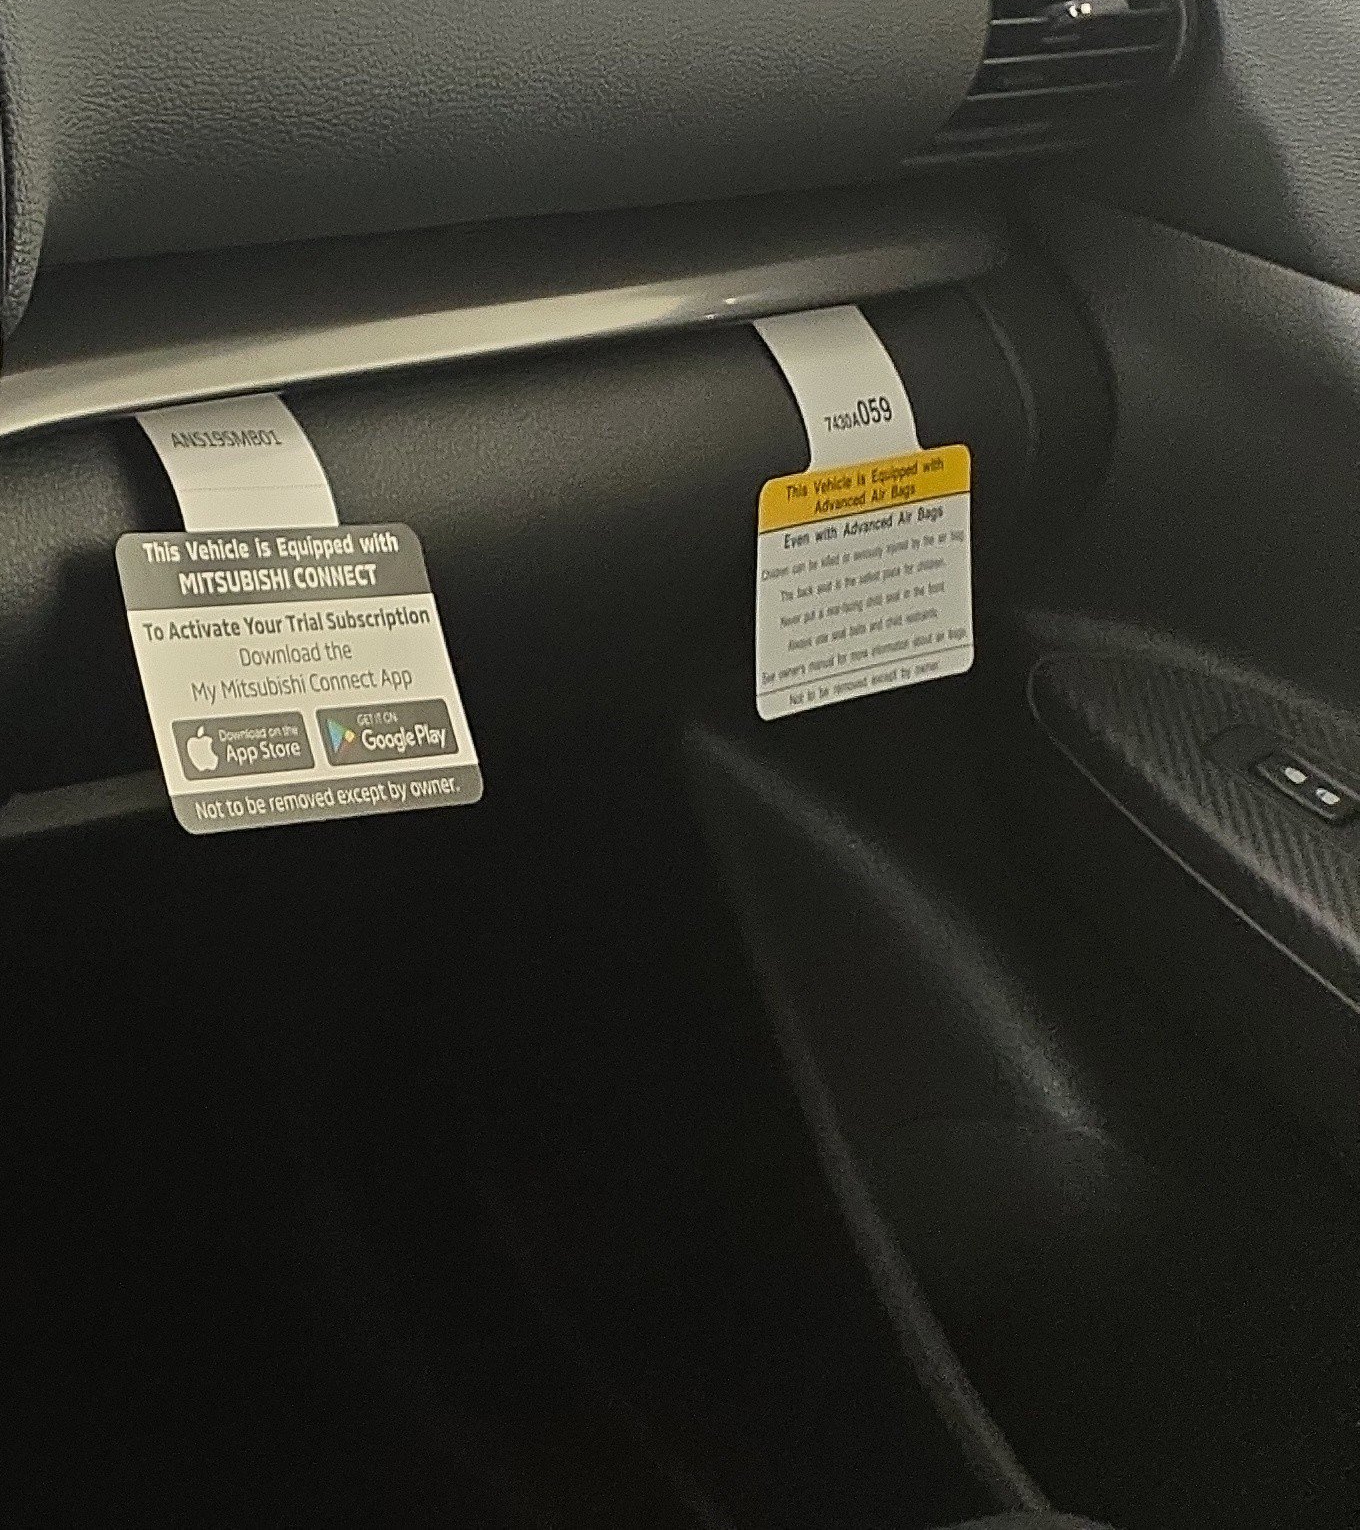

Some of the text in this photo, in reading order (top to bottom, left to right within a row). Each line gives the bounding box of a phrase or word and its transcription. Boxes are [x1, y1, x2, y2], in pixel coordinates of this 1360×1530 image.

[823, 395, 893, 433] 7430A059
[142, 531, 399, 563] This Vehicle is Equipped with
[178, 563, 378, 596] MITSUBISHI CONNECT
[143, 606, 430, 642] To Activate Your Trial Subscription
[239, 641, 353, 667] Download the
[191, 668, 413, 705] My Mitsubishi Connect App
[225, 739, 302, 767] App Store
[360, 722, 448, 754] Google Play
[194, 776, 461, 821] Not to be removed except by owner.
